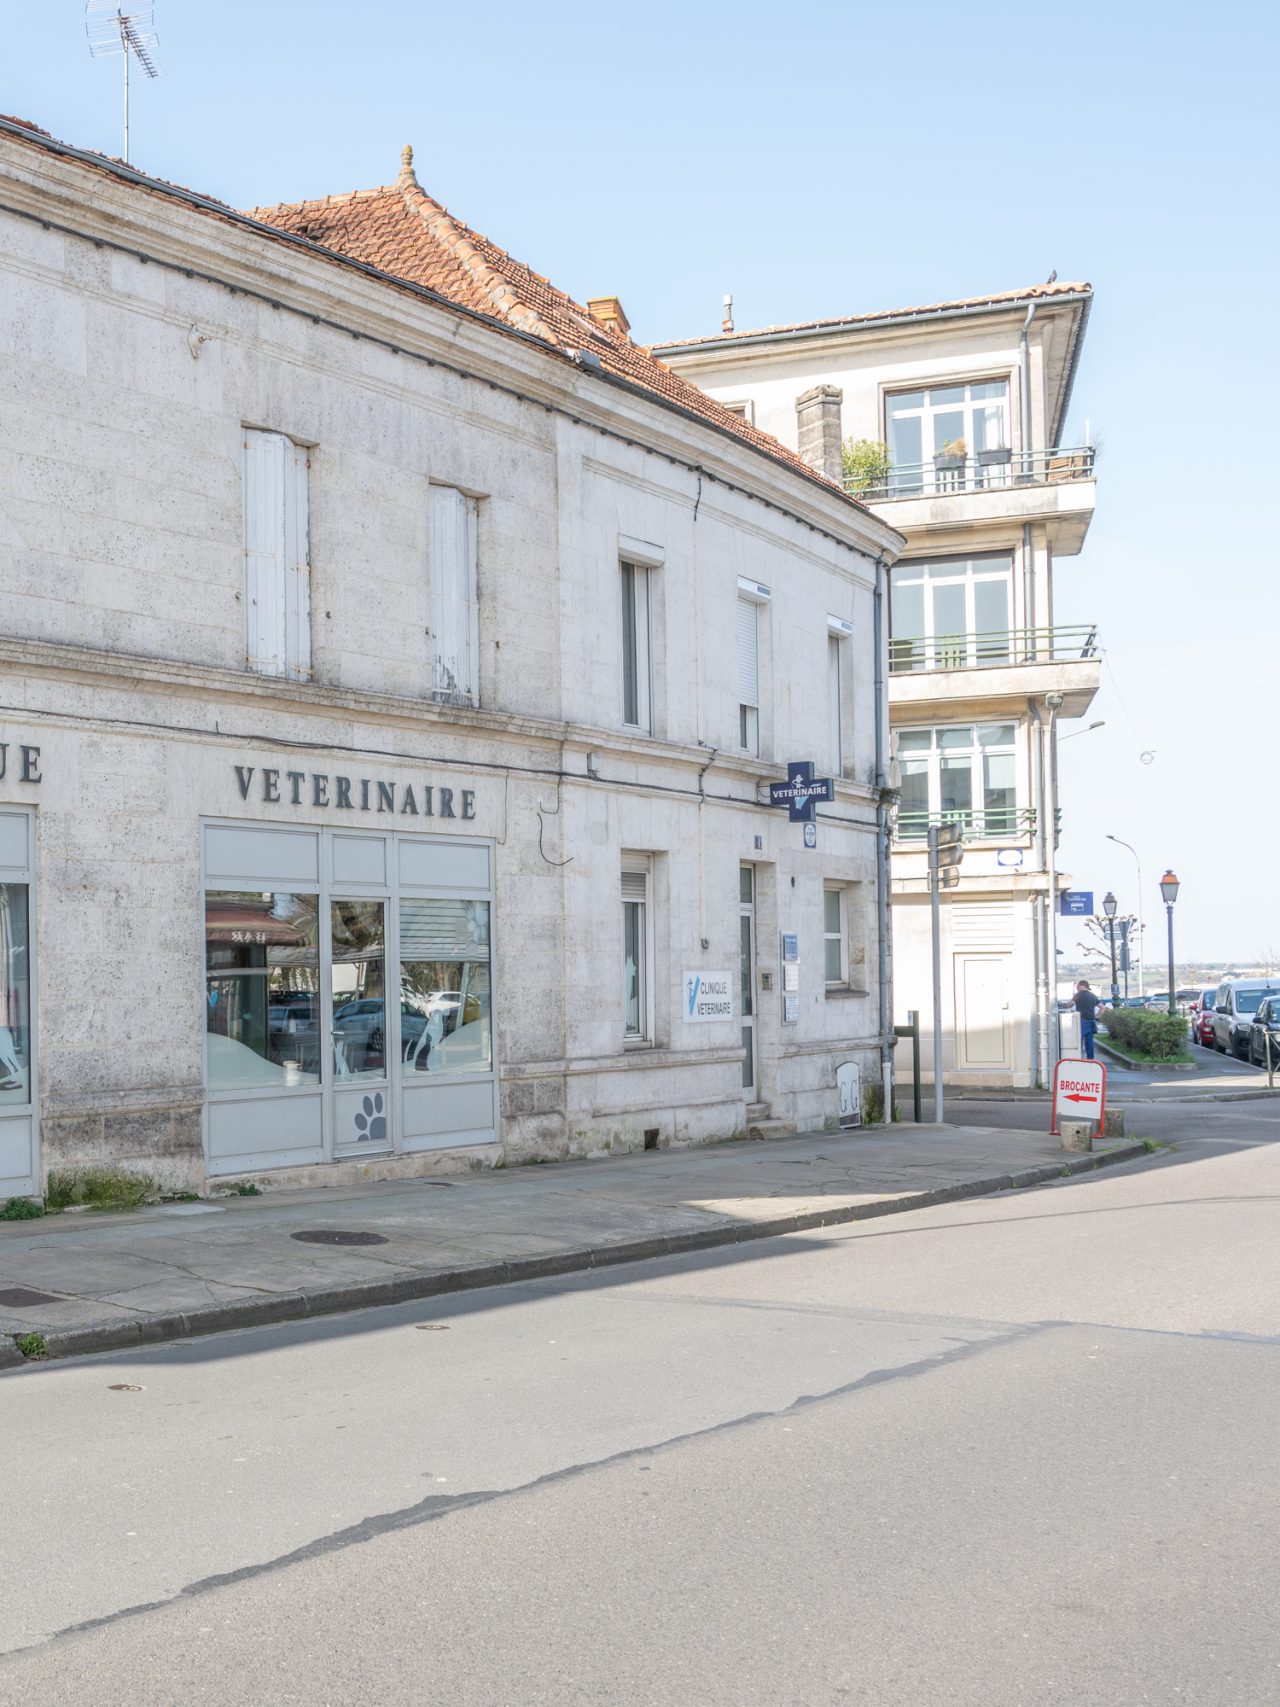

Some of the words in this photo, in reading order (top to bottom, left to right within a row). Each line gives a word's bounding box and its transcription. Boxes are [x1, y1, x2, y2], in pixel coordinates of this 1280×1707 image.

[234, 766, 476, 820] VETERINAIRE
[772, 786, 827, 798] VETERINAIRE
[700, 981, 727, 995] CLINIQUE
[696, 1002, 731, 1015] VETERINAIRE
[1060, 1080, 1100, 1093] BROCANTE
